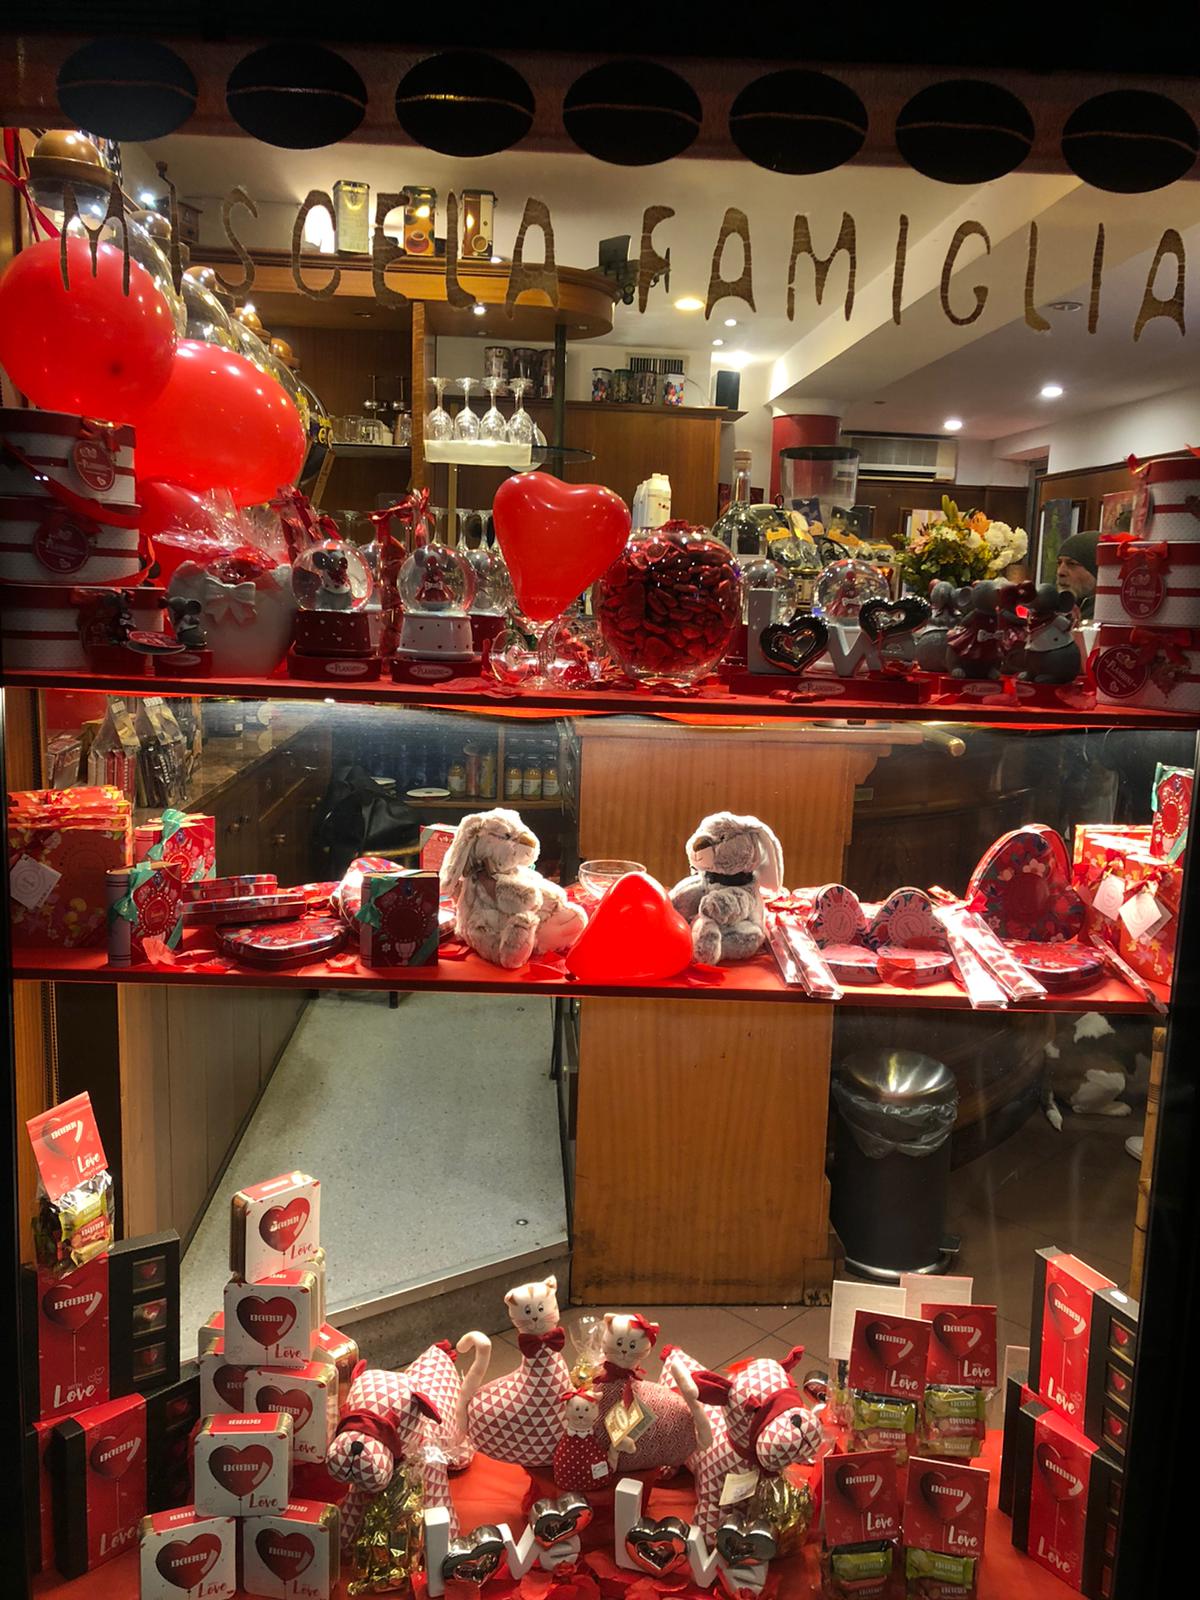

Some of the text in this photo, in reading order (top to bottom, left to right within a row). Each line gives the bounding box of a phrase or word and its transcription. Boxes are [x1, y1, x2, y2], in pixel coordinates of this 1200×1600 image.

[61, 180, 1187, 343] MISCELA FAMIGLIA
[77, 1152, 101, 1174] Love
[54, 1293, 94, 1310] BABBI
[274, 1343, 302, 1359] Love
[963, 1359, 992, 1378] Love
[890, 1370, 919, 1391] Love
[54, 1384, 96, 1409] Love
[1048, 1376, 1076, 1415] Love
[249, 1493, 279, 1509] Love
[867, 1512, 894, 1531] Love
[99, 1524, 137, 1557] Love
[948, 1525, 978, 1548] Love
[1038, 1535, 1072, 1574] Love
[198, 1581, 227, 1598] Love
[292, 1580, 320, 1597] Love
